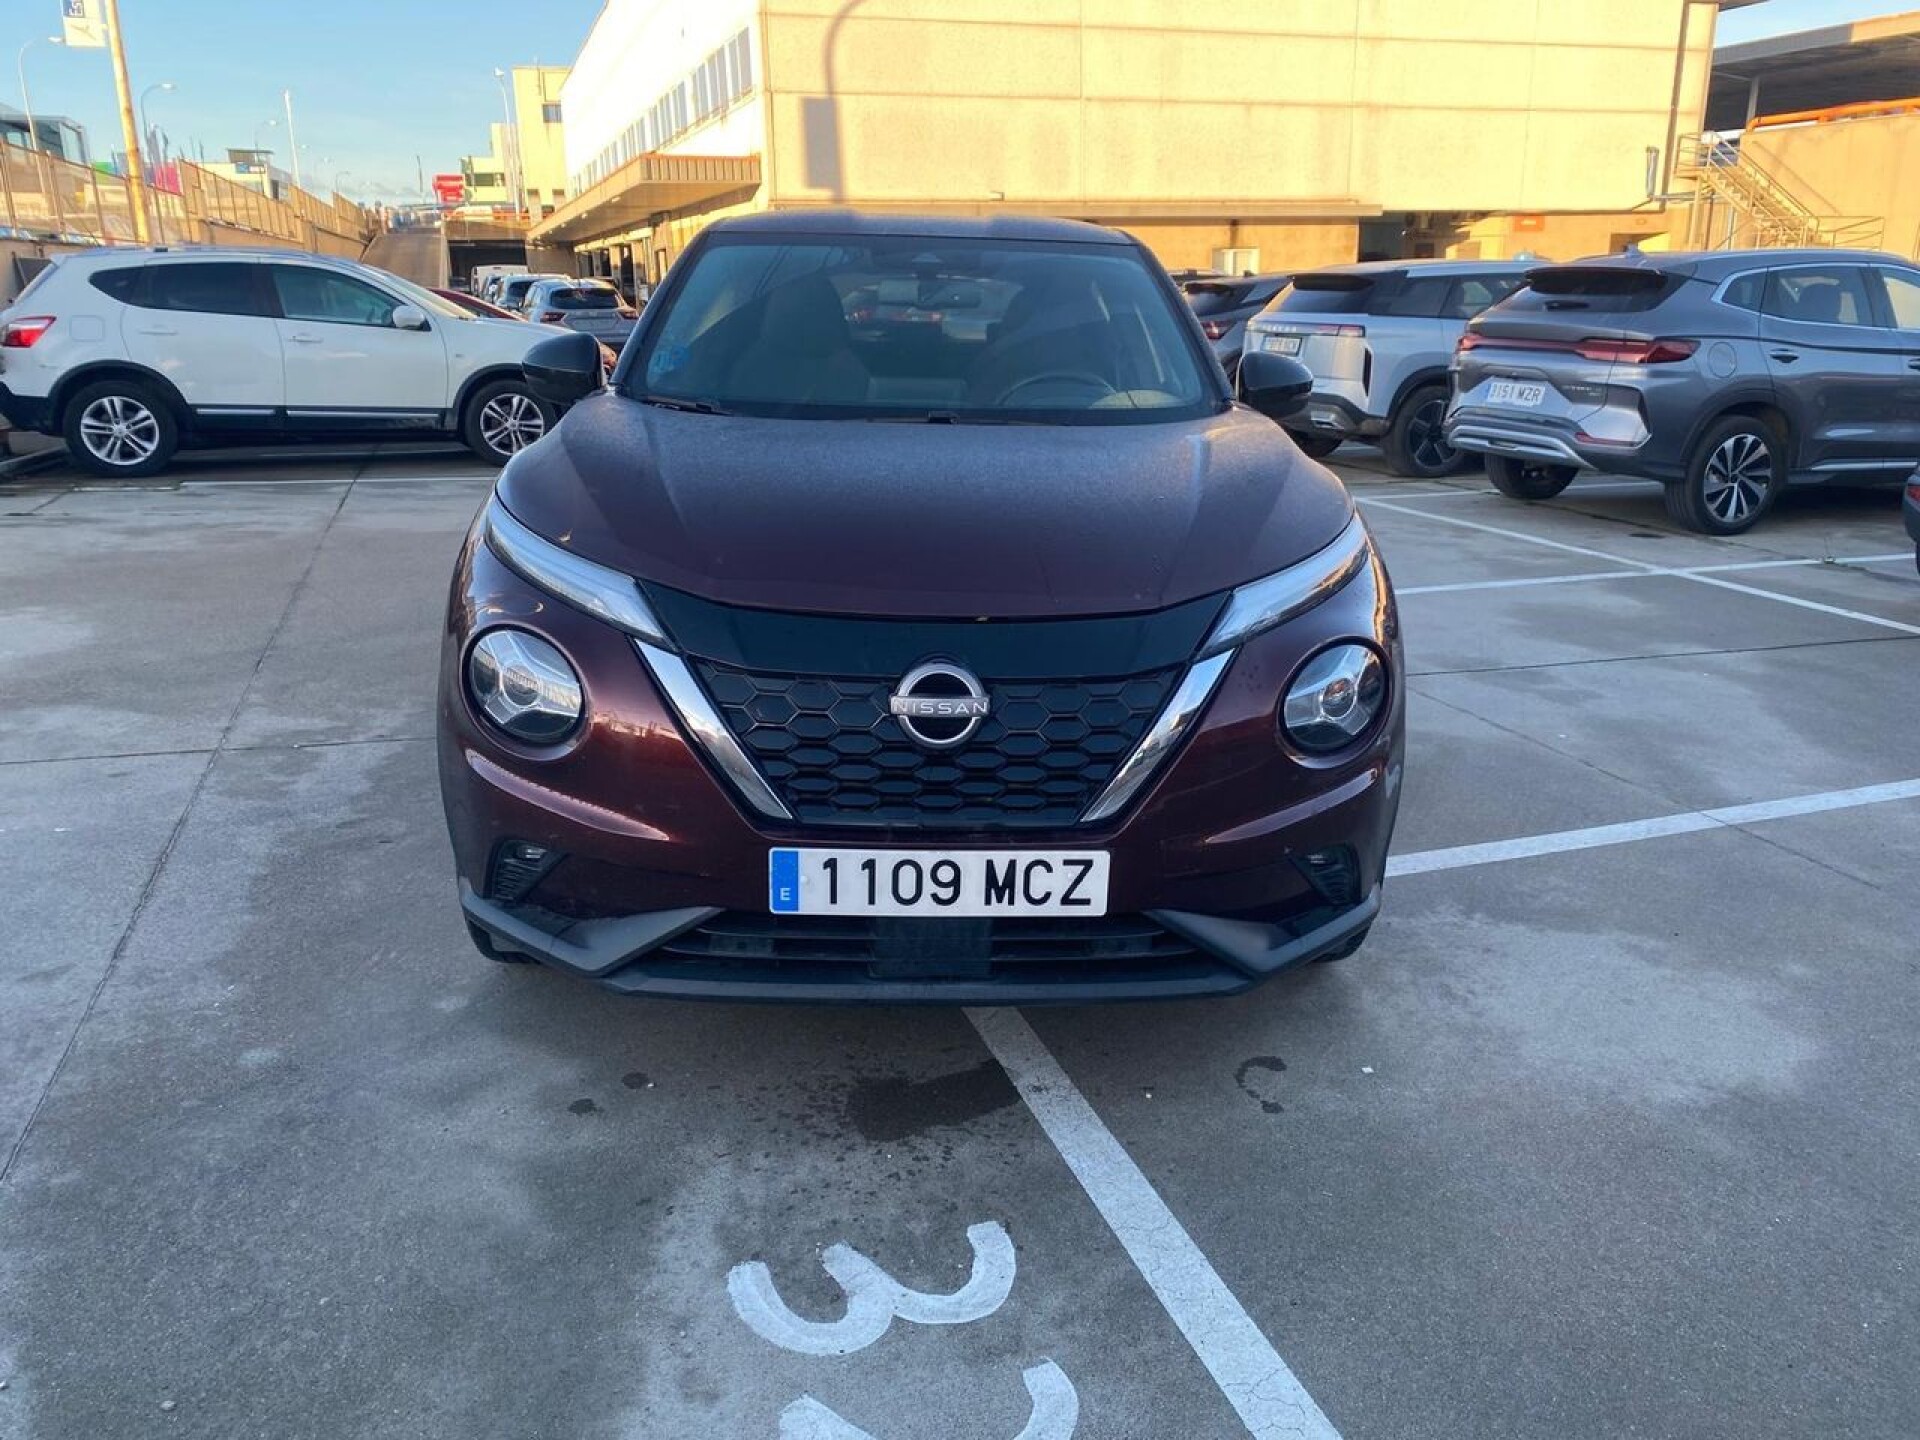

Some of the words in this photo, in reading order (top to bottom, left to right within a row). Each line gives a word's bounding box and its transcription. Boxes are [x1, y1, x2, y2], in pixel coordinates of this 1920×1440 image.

[1516, 386, 1542, 402] MZR
[892, 698, 988, 715] NISSAN
[821, 857, 962, 907] 1109
[983, 858, 1095, 907] MCZ
[779, 887, 791, 901] E
